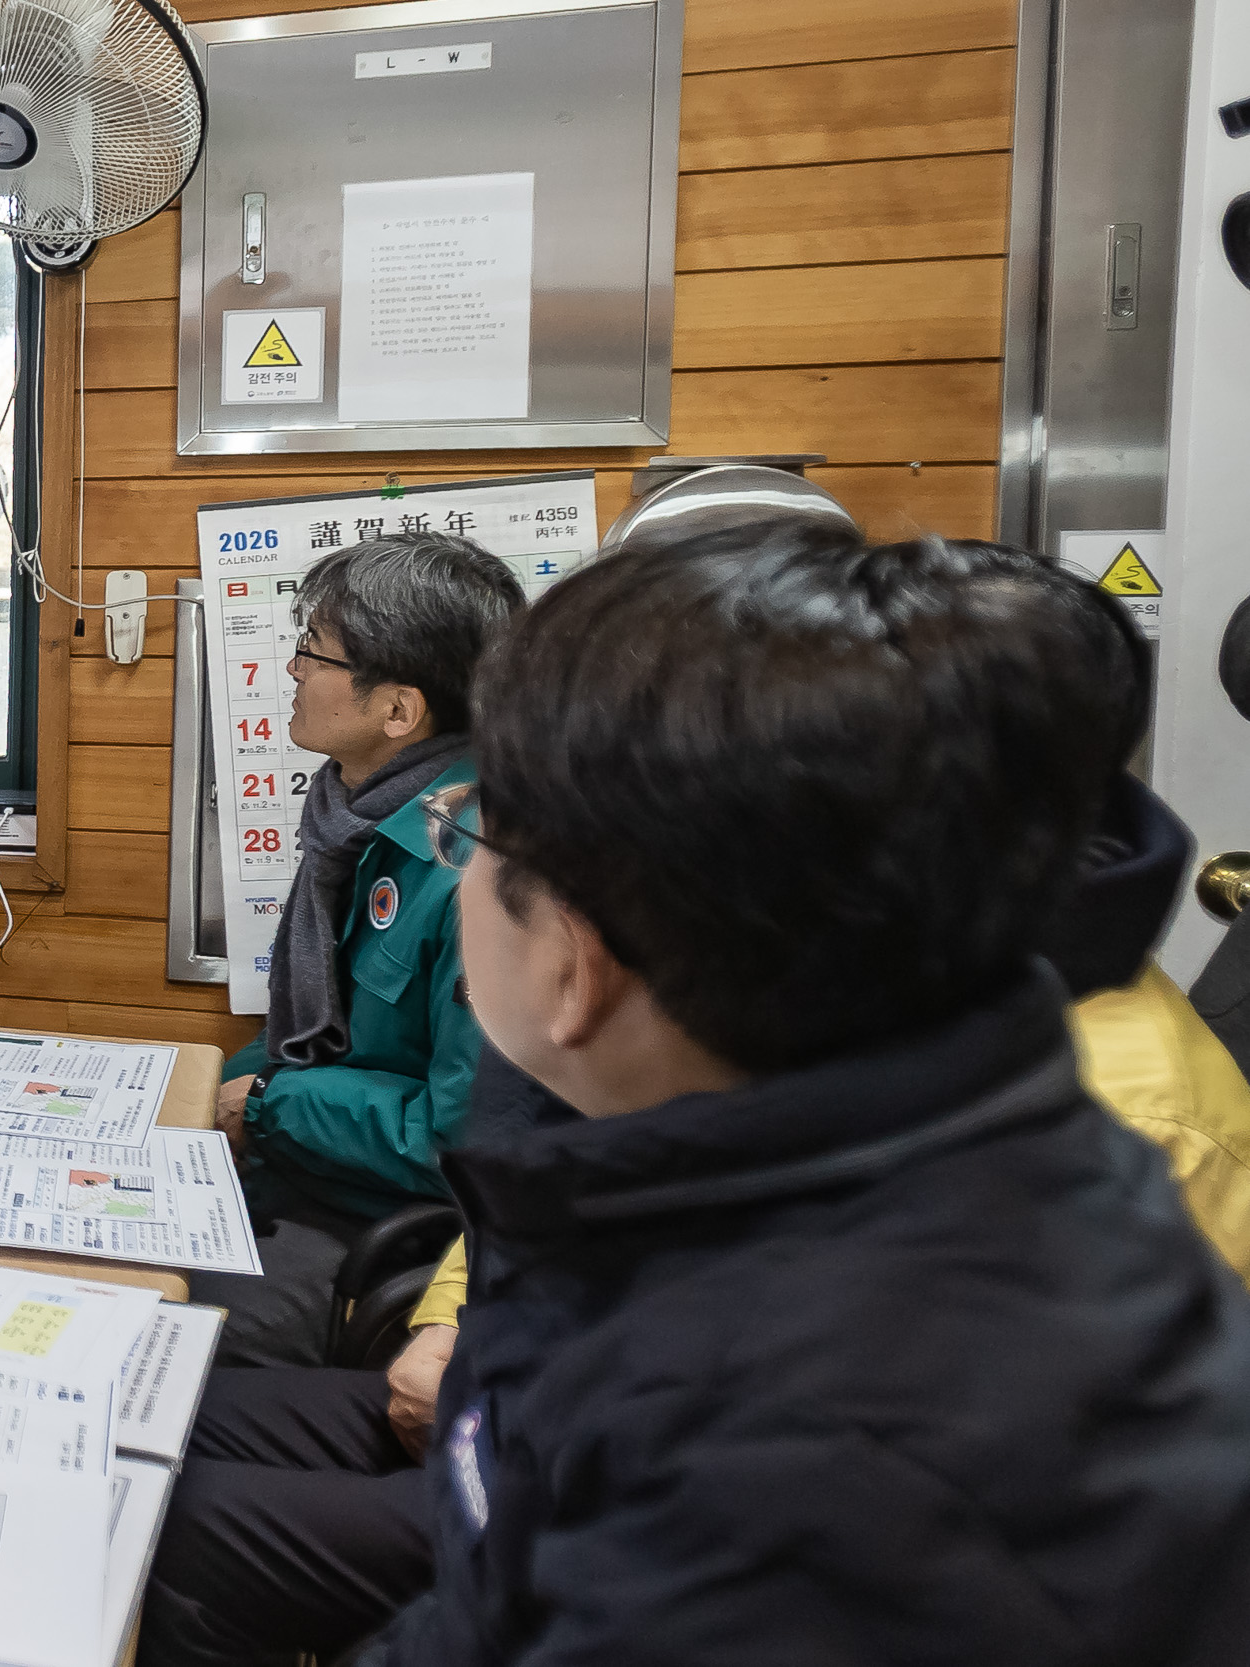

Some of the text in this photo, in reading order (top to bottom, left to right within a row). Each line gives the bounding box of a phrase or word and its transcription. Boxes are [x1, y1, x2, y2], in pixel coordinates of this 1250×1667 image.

[387, 57, 396, 69] L
[448, 51, 460, 63] W
[248, 372, 297, 385] 감전 주의
[535, 506, 578, 522] 4359
[219, 529, 279, 552] 2026
[535, 525, 578, 539] 丙午年
[218, 553, 278, 566] CALENDAR
[535, 559, 559, 576] 土
[227, 582, 248, 598] 日
[276, 580, 299, 596] 月
[241, 662, 259, 686] 7
[236, 717, 272, 742] 14
[242, 772, 276, 798] 21
[243, 828, 281, 853] 28
